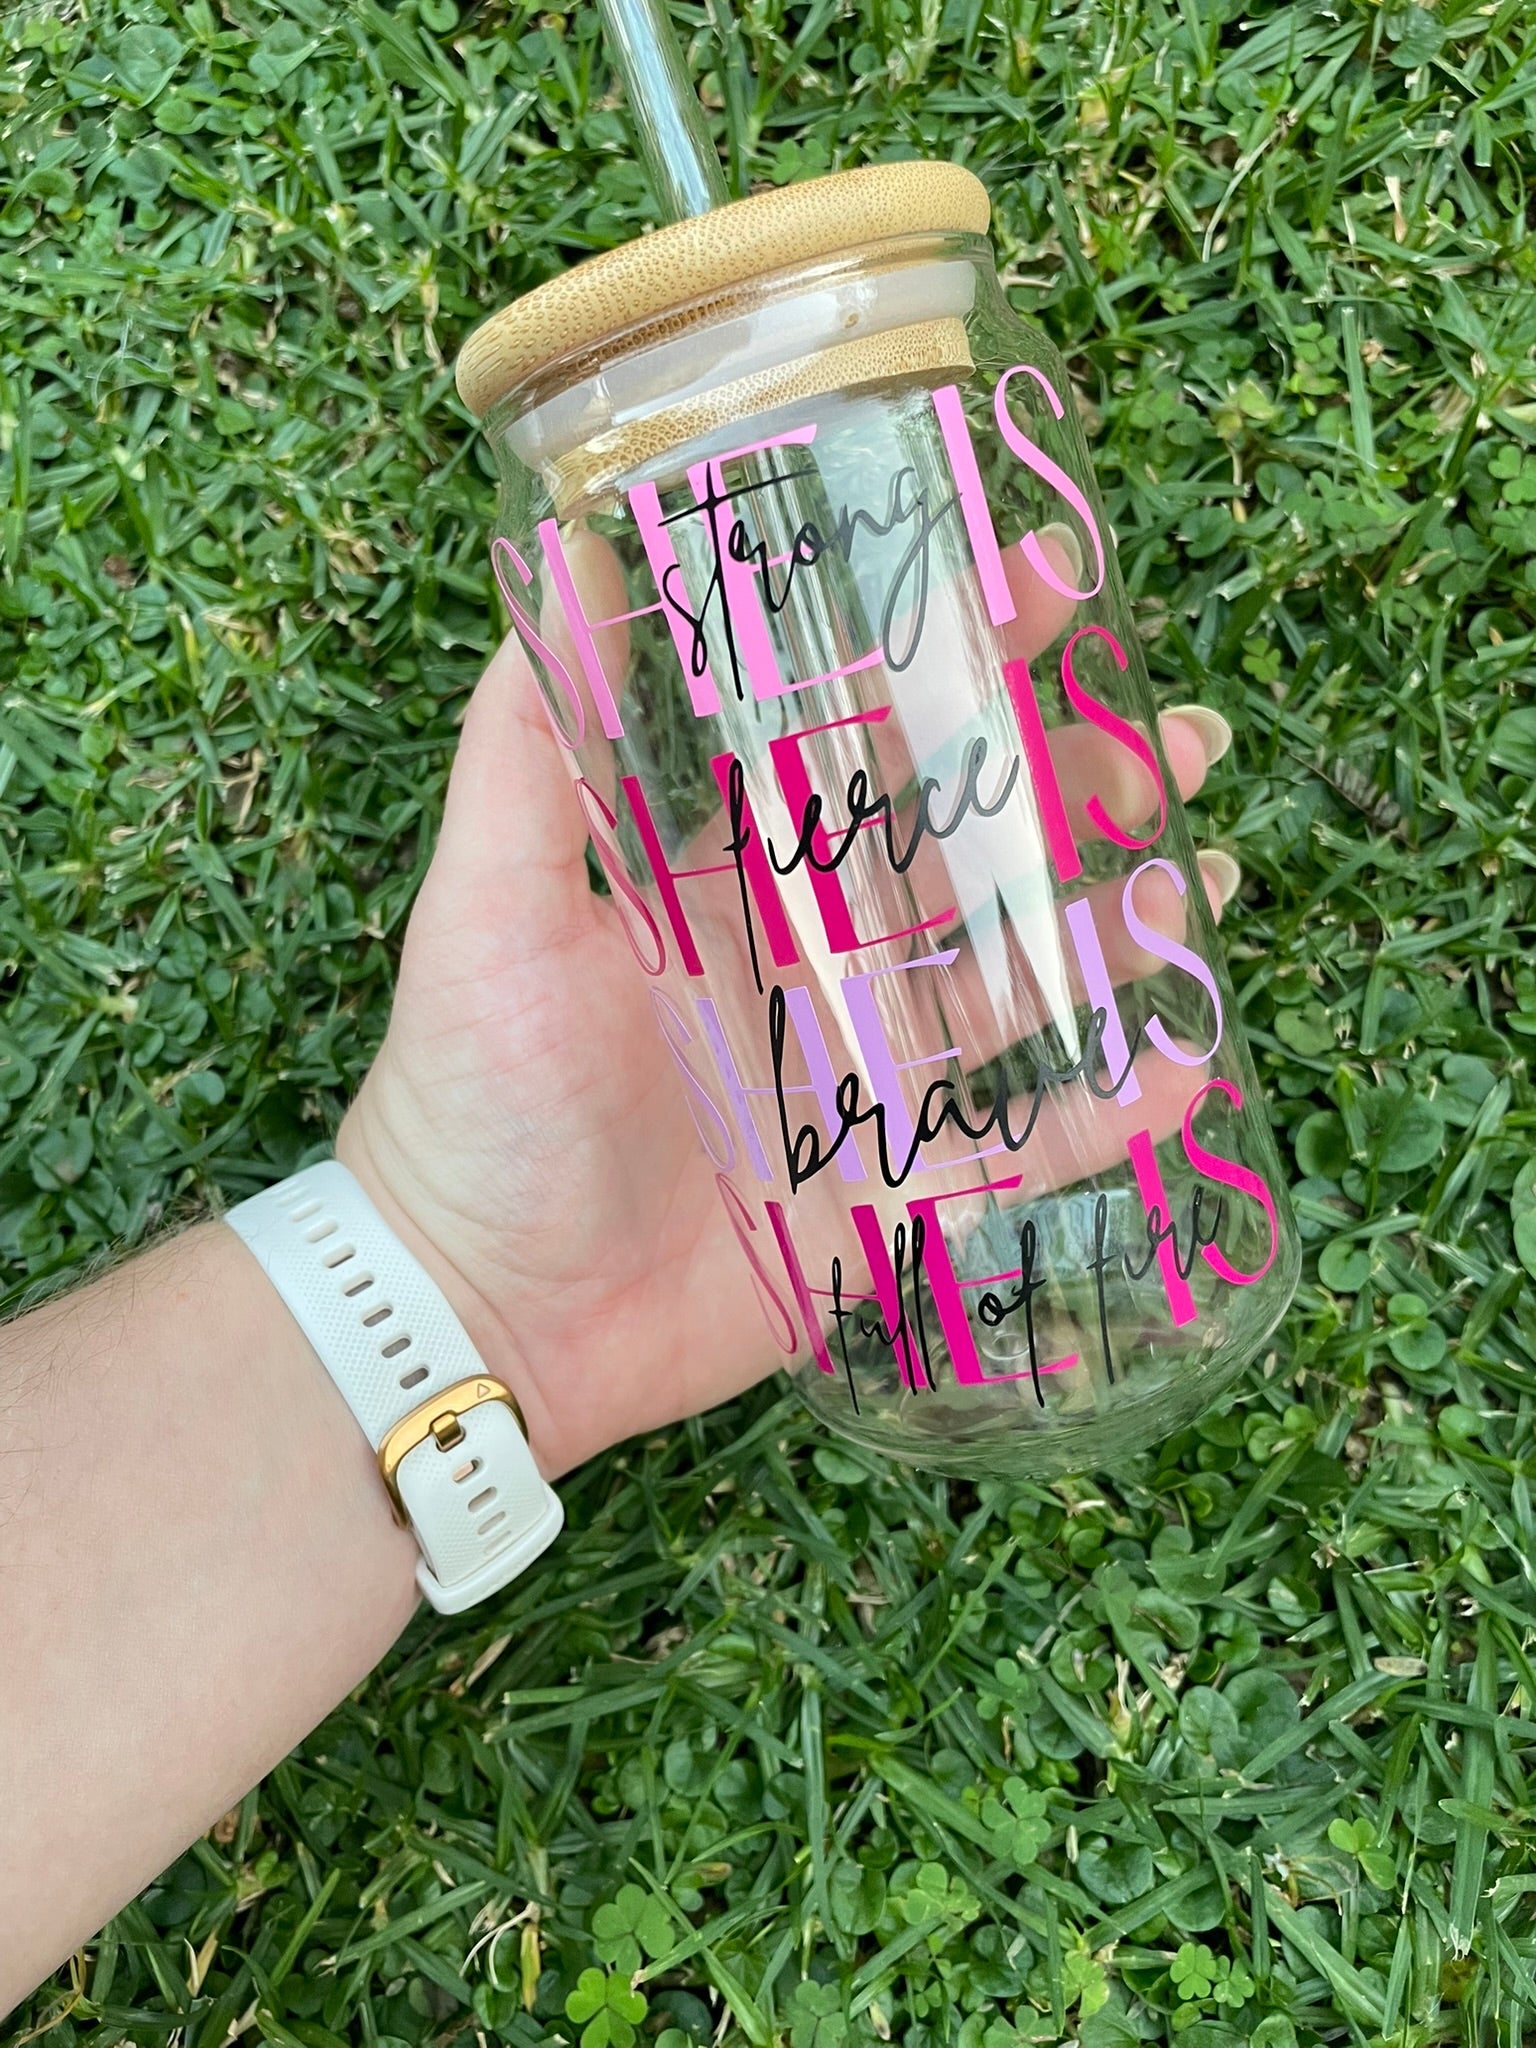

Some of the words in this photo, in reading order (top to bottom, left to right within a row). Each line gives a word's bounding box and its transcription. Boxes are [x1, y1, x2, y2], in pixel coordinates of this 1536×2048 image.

[491, 424, 886, 751] SHE
[932, 364, 1106, 626] IS
[657, 461, 963, 701] strong
[575, 705, 957, 977] SHE
[1002, 625, 1167, 883] IS
[723, 737, 1019, 995] fierce
[650, 947, 1024, 1183] SHE
[1065, 857, 1224, 1107] IS
[768, 984, 1141, 1195] brave
[716, 1173, 1079, 1388] SHE
[1126, 1079, 1278, 1328] IS
[829, 1214, 937, 1416] full
[977, 1219, 1047, 1409] of
[1087, 1185, 1223, 1386] fire
